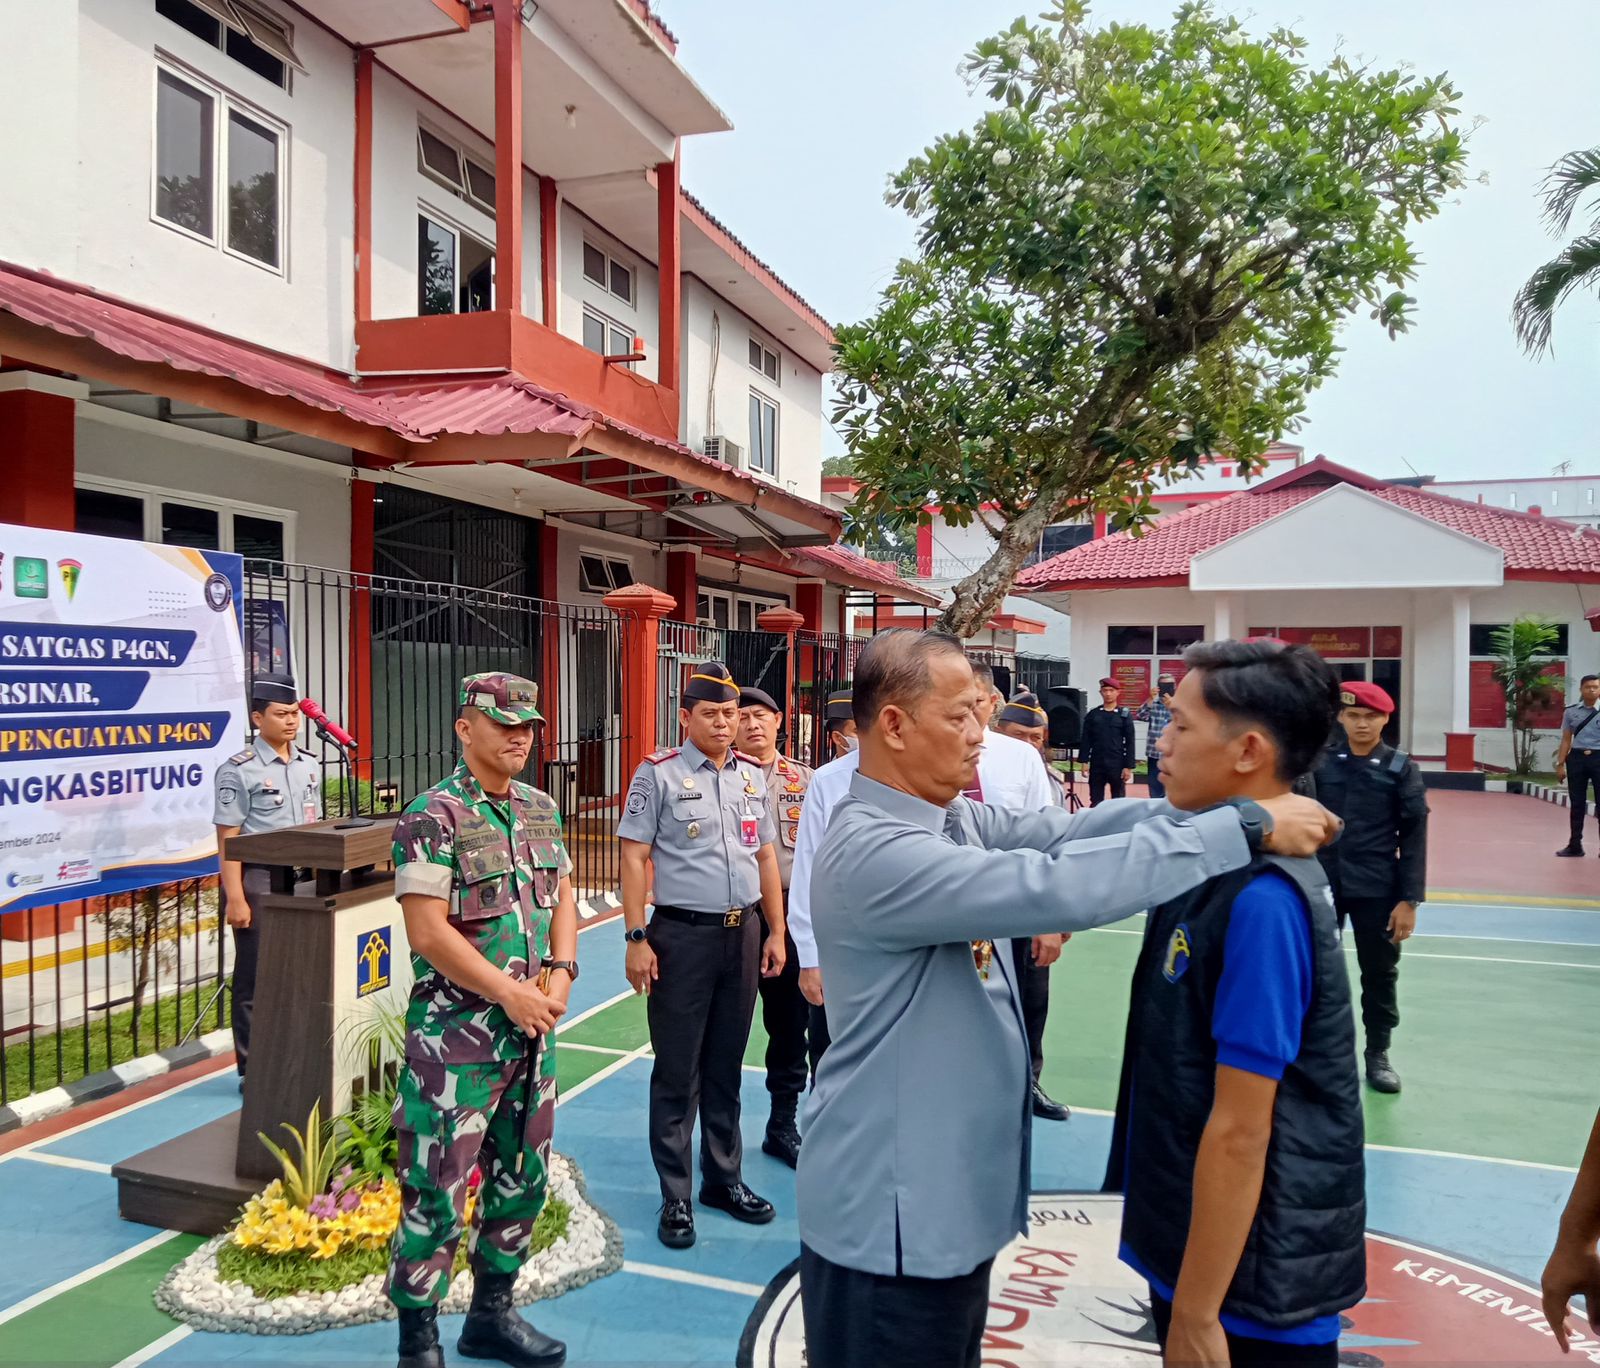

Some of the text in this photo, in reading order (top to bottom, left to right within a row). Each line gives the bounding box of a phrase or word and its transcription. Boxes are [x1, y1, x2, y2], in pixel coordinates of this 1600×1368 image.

[2, 635, 177, 663] SATGAS P4GN,
[0, 682, 100, 706] RSINAR,
[0, 722, 212, 752] PENGUATAN P4GN
[0, 763, 203, 806] NGKASBITUNG
[35, 831, 62, 845] 2024
[1027, 1209, 1093, 1227] Prof
[999, 1245, 1078, 1308] KAMI
